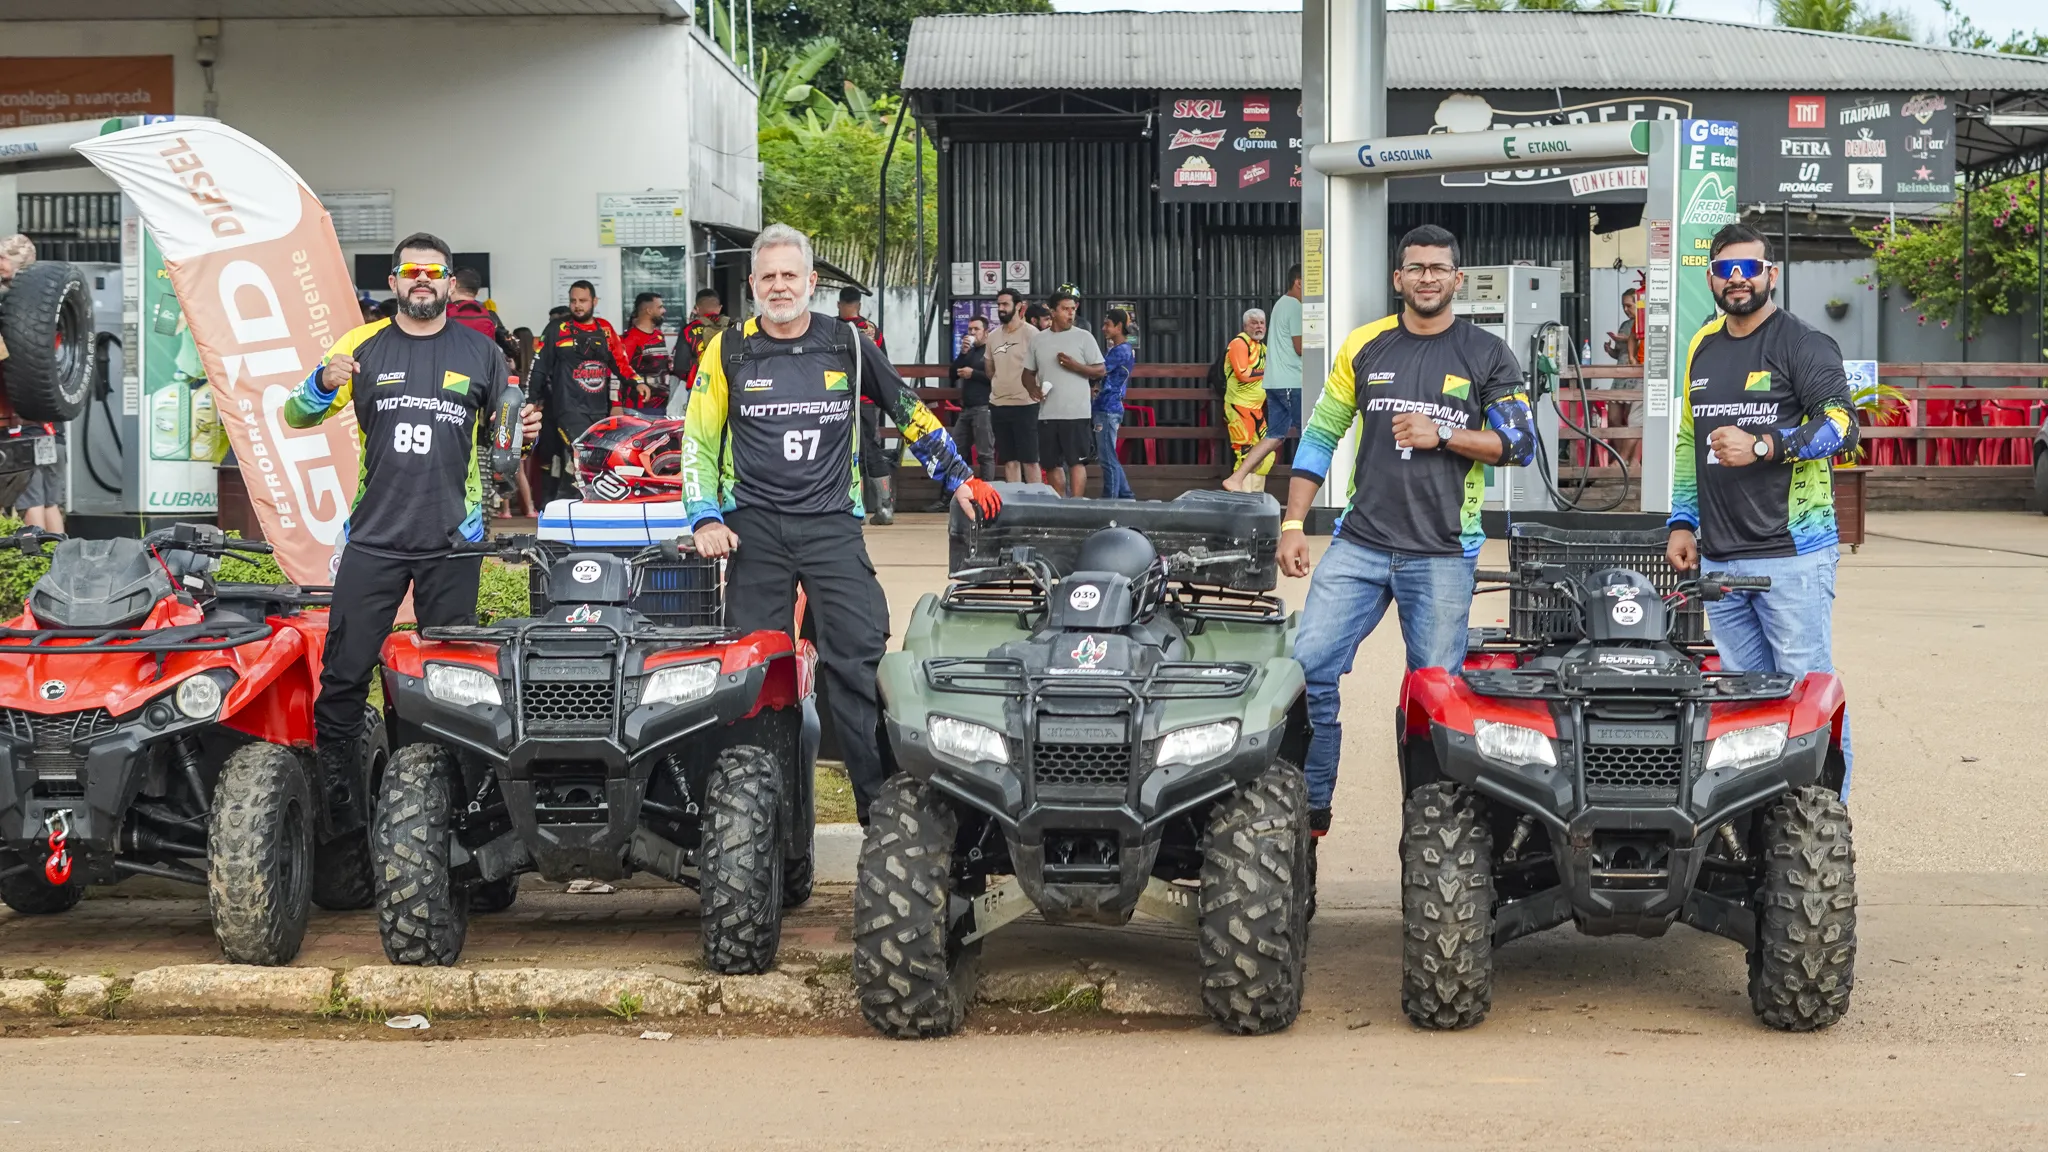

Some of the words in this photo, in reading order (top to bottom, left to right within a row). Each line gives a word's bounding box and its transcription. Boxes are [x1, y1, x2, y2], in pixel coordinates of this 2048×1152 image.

[0, 89, 70, 109] cnologia
[74, 88, 151, 107] avançada
[1173, 99, 1227, 120] SKOL
[1795, 104, 1820, 123] TNT
[1839, 103, 1891, 125] ITAIPAVA
[1689, 120, 1709, 142] G
[1169, 132, 1225, 147] Budweiser
[1233, 136, 1278, 152] Corona
[1780, 139, 1832, 156] PETRA
[1358, 145, 1376, 168] G
[1380, 148, 1433, 162] GASOLINA
[1503, 137, 1521, 160] E
[1527, 140, 1572, 154] ETANOL
[1689, 144, 1706, 170] E
[1710, 152, 1738, 168] Etan
[1179, 171, 1212, 182] BRAHMA
[1572, 167, 1647, 195] CONVENIÊN
[159, 136, 247, 239] DIESEL
[1778, 182, 1833, 193] IRONAGE
[1896, 181, 1950, 193] Heineken
[1696, 201, 1727, 212] REDE
[1681, 255, 1708, 267] REDE
[376, 372, 405, 381] RACER
[744, 378, 773, 388] RACER
[1368, 372, 1395, 382] RACER
[740, 400, 850, 418] MOTOPREMIUM
[1692, 402, 1779, 418] OTOPREMIUM
[1737, 415, 1778, 427] OFFROAD
[393, 422, 433, 454] 89
[782, 430, 821, 461] 67
[238, 397, 297, 530] PETROBRAS
[1794, 465, 1810, 535] BRASIL
[575, 565, 598, 573] 075
[1073, 590, 1097, 600] 039
[1615, 606, 1636, 614] 102
[535, 666, 605, 676] HONDA
[1046, 727, 1119, 739] HONDA
[1597, 728, 1669, 740] HONDA
